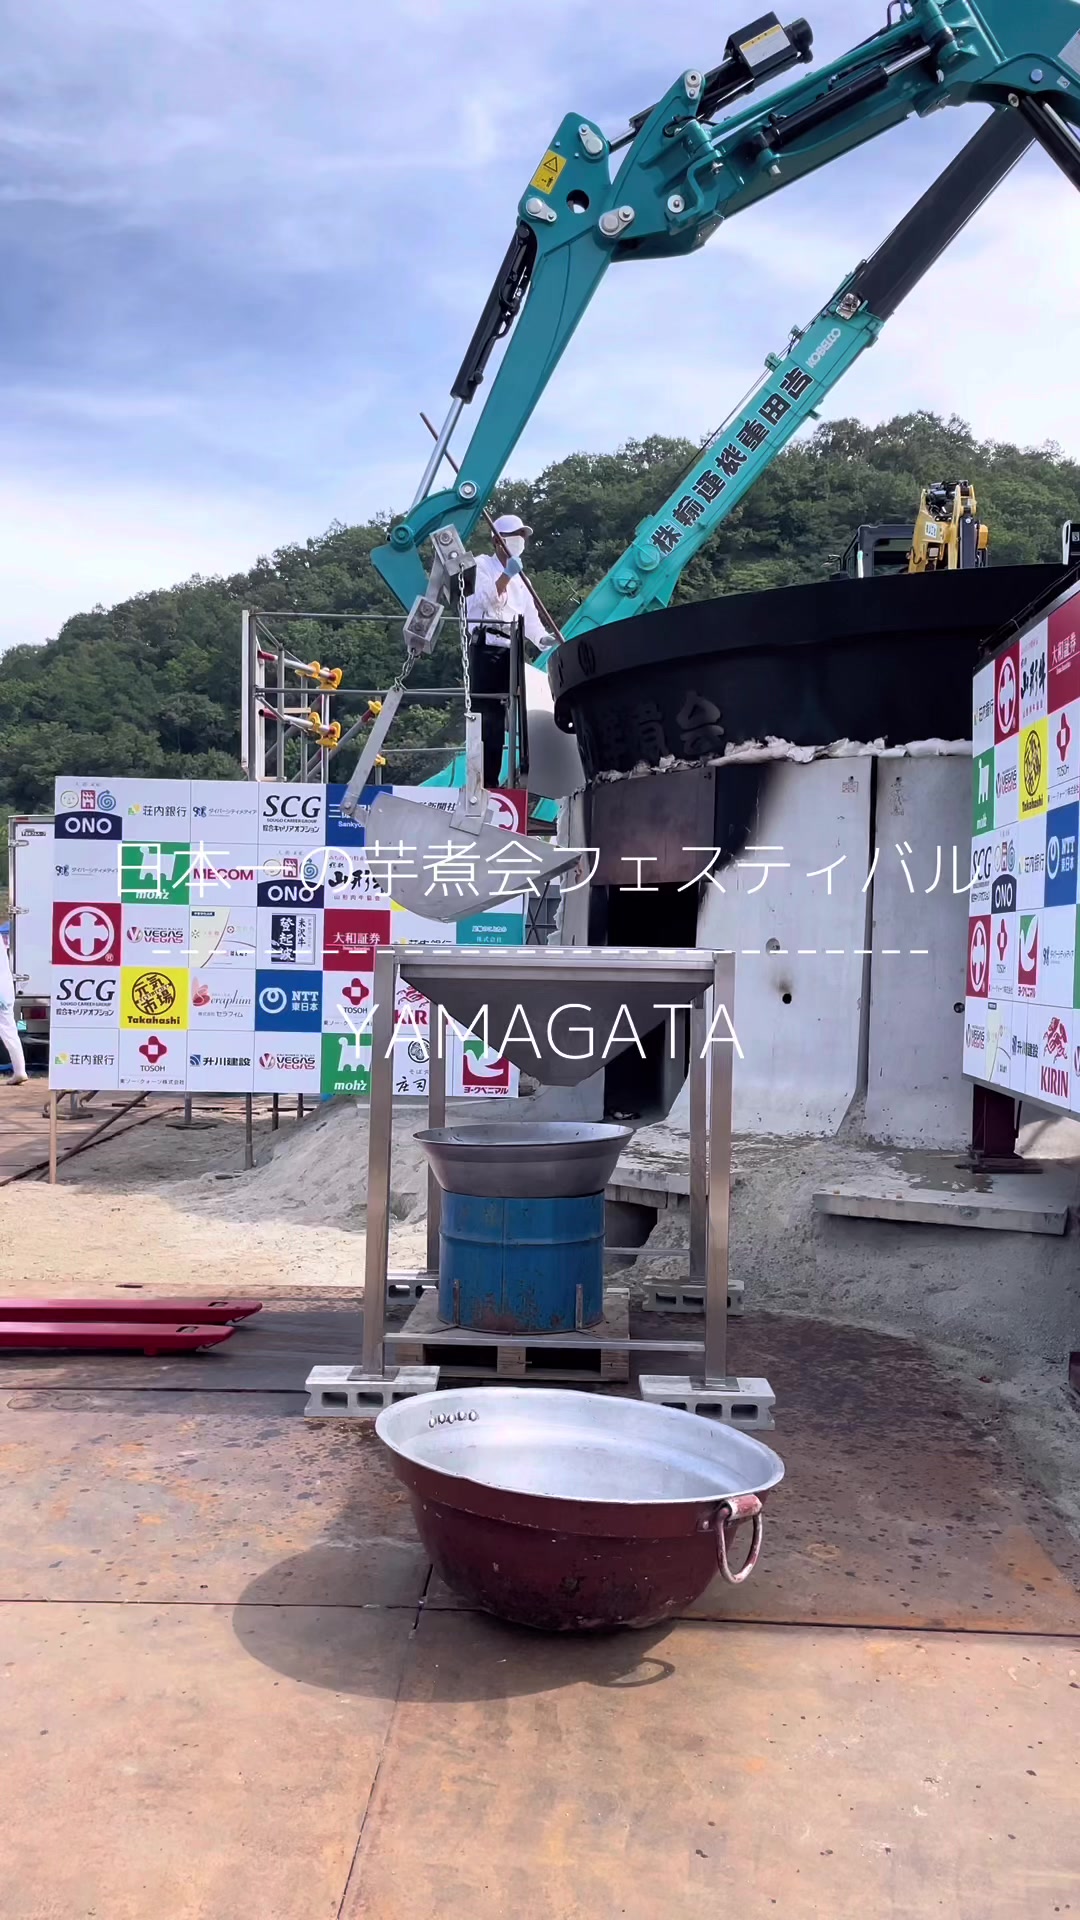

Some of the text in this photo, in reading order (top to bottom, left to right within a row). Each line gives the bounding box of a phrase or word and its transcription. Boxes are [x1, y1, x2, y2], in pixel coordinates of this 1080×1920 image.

[805, 327, 841, 369] KOBELCO
[142, 805, 187, 818] 荘内銀行
[262, 795, 322, 818] SCG
[64, 817, 113, 834] ONO
[262, 824, 320, 833] 総合キャリアオプション
[1061, 835, 1075, 855] NTT
[972, 846, 992, 880] SCG
[193, 868, 254, 881] MECOM
[268, 885, 315, 902] ONO
[995, 882, 1013, 908] ONO
[144, 930, 184, 938] VEGAS
[279, 917, 295, 961] 登起波
[297, 917, 306, 949] 米沢牛
[332, 931, 381, 944] 大和証券
[56, 978, 117, 1002] SCG
[291, 990, 319, 1001] NTT
[56, 1008, 115, 1017] 総合キャリアオプション
[291, 1002, 319, 1012] 東日本
[343, 1006, 368, 1014] TOSOH
[127, 1015, 181, 1025] Takahashi
[216, 1010, 244, 1018] セラフィム
[69, 1054, 115, 1066] 荘内銀行
[202, 1056, 251, 1067] 升川建設
[276, 1056, 316, 1064] VEGAS
[1040, 1065, 1069, 1098] KIRIN
[463, 1086, 509, 1095] ヨークベニマル
